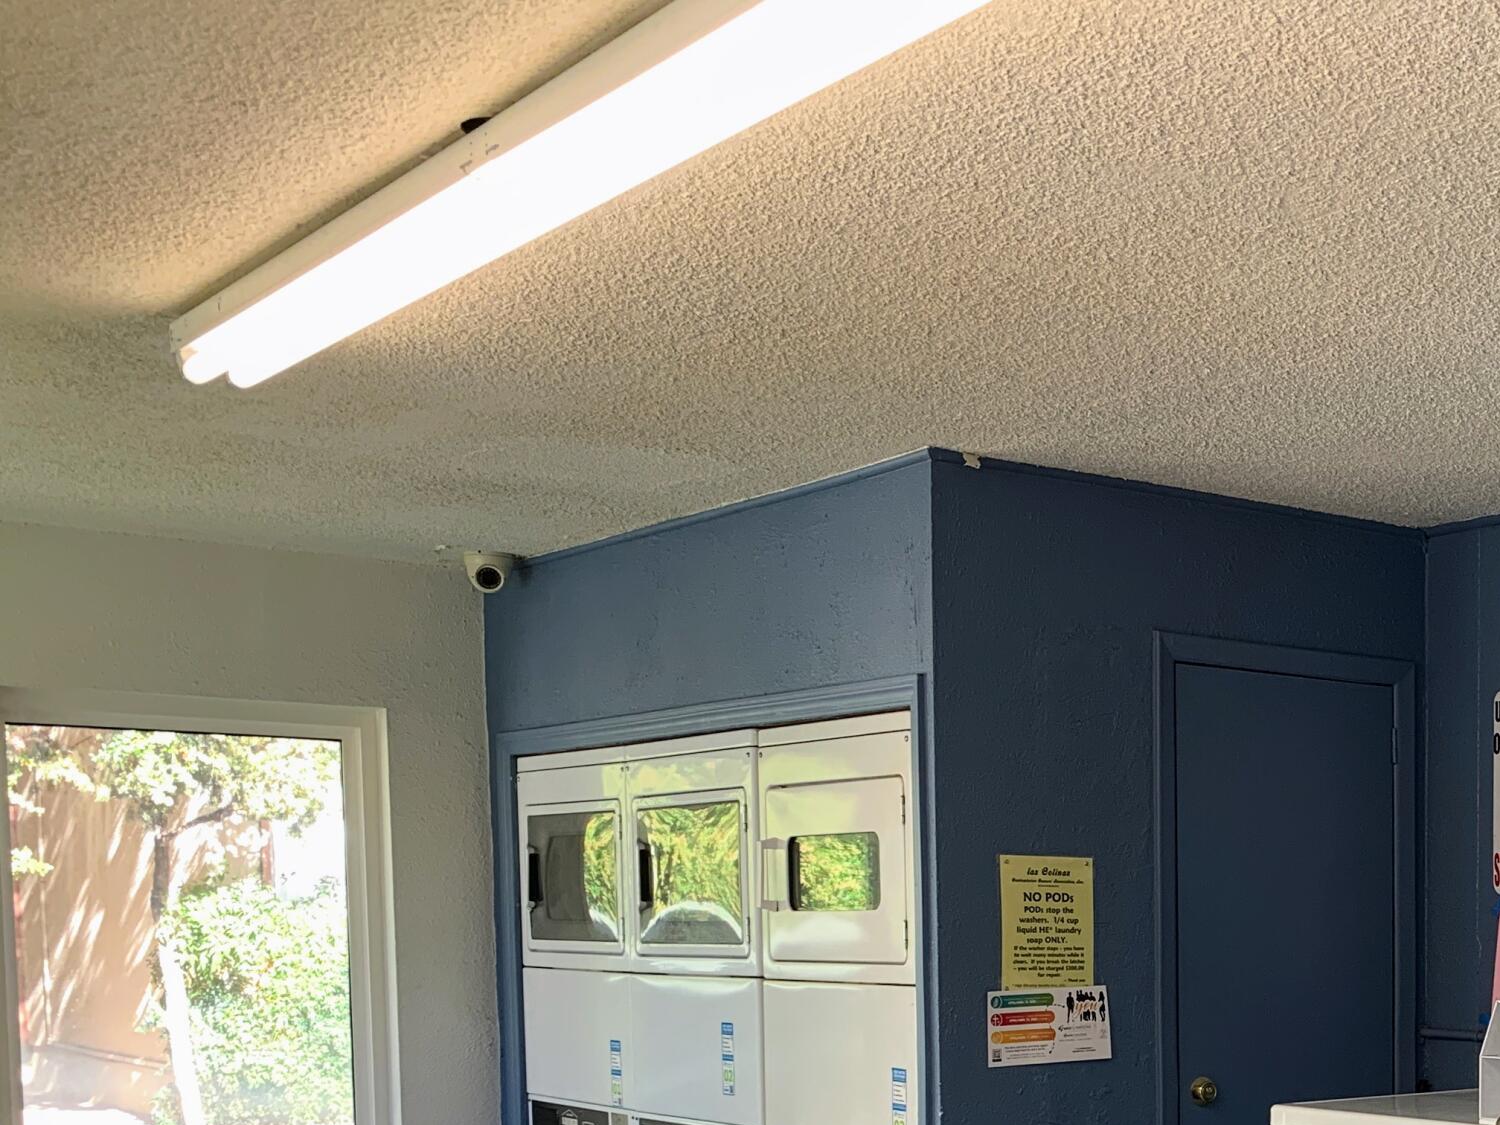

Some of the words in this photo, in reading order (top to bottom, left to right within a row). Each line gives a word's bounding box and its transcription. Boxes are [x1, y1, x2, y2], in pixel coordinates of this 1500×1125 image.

[1024, 892, 1042, 902] NO
[1046, 892, 1074, 903] PODs
[1062, 906, 1074, 914] the
[1016, 926, 1037, 934] liquid
